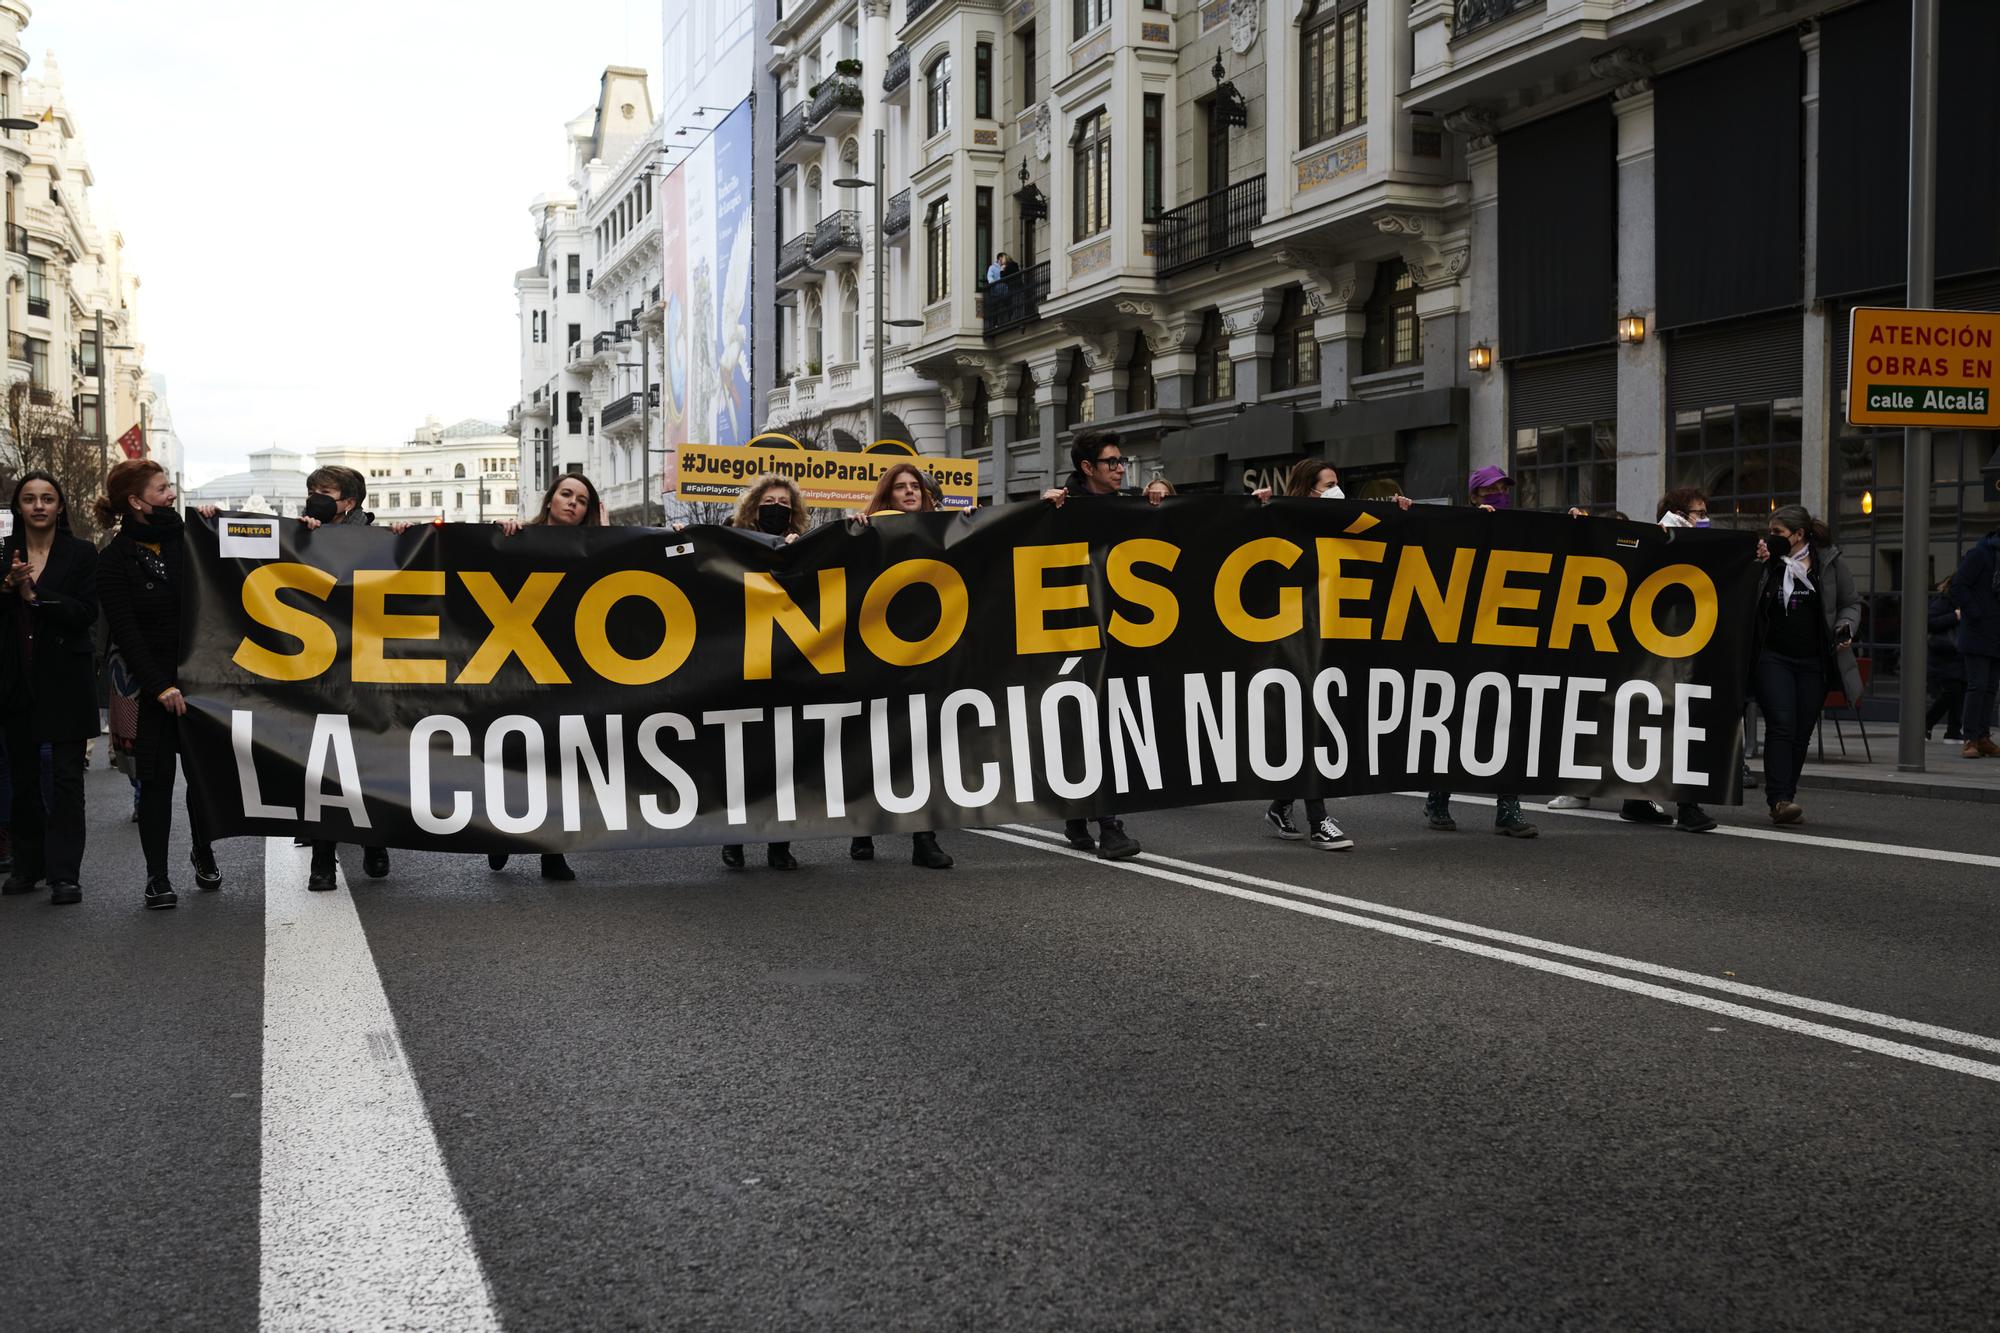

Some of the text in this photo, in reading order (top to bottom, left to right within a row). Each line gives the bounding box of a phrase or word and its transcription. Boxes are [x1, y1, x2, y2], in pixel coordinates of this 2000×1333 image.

[1869, 324, 1992, 348] ATENCIÓN
[1866, 355, 1992, 379] OBRAS EN
[1870, 389, 1985, 411] calle Alcalá
[228, 526, 272, 536] #HARTAS
[231, 512, 1718, 686] SEXO NO ES GÉNERO
[231, 657, 1712, 835] LA CONSTITUCIÓN NOS PROTEGE
